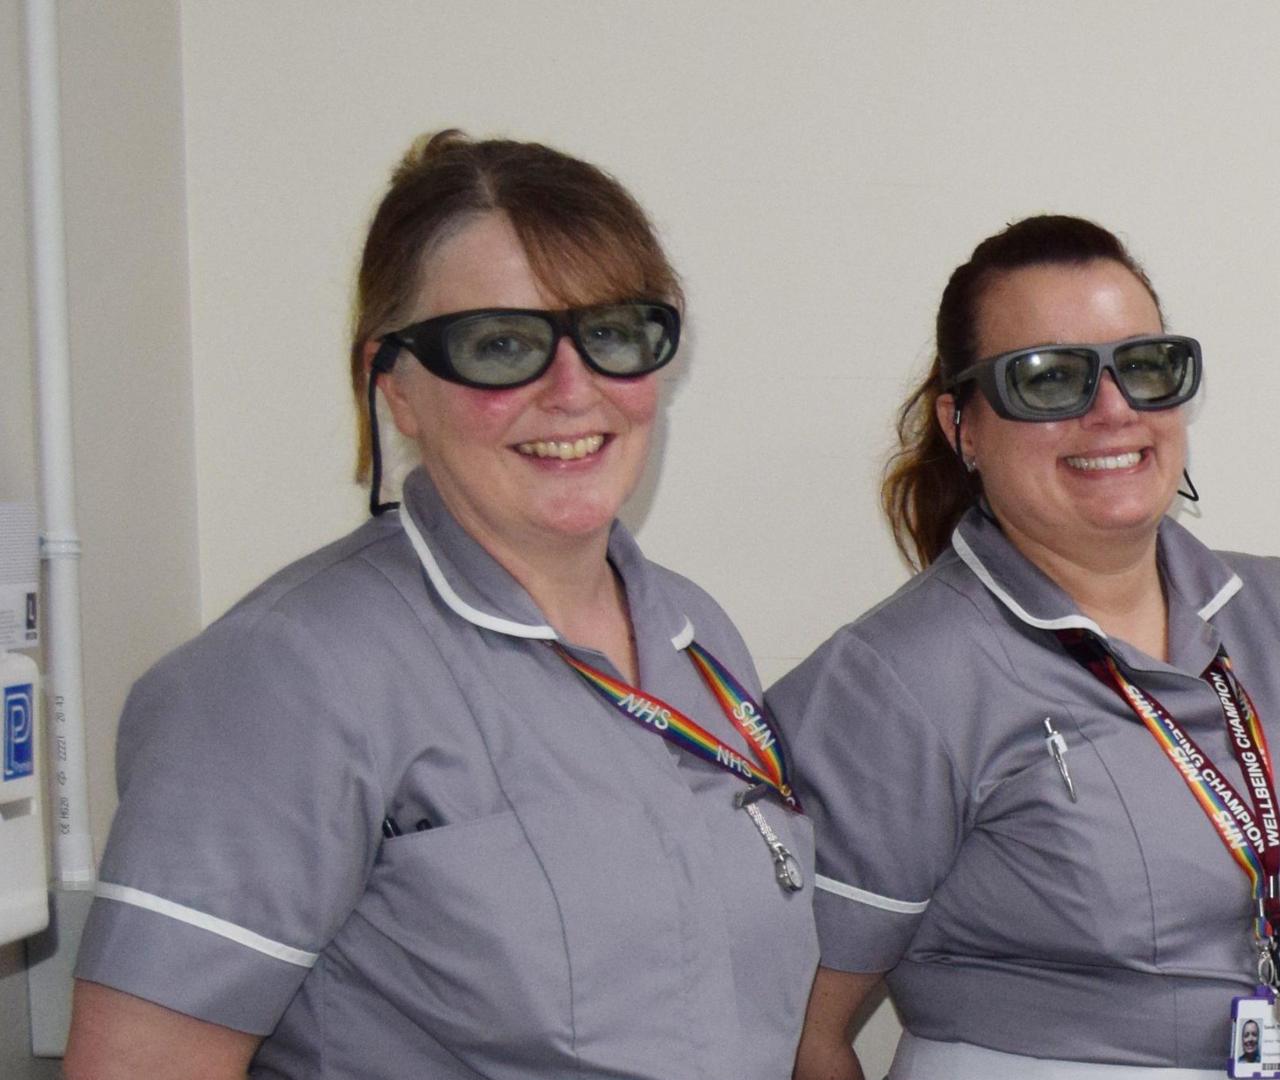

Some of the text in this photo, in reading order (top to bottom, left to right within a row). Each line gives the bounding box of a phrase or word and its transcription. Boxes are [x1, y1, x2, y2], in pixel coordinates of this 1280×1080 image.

[618, 692, 672, 731] NHS
[732, 701, 775, 751] NHS
[1210, 671, 1251, 749] CHAMPION
[716, 744, 753, 778] NHS
[1242, 751, 1280, 847] WELLBEING
